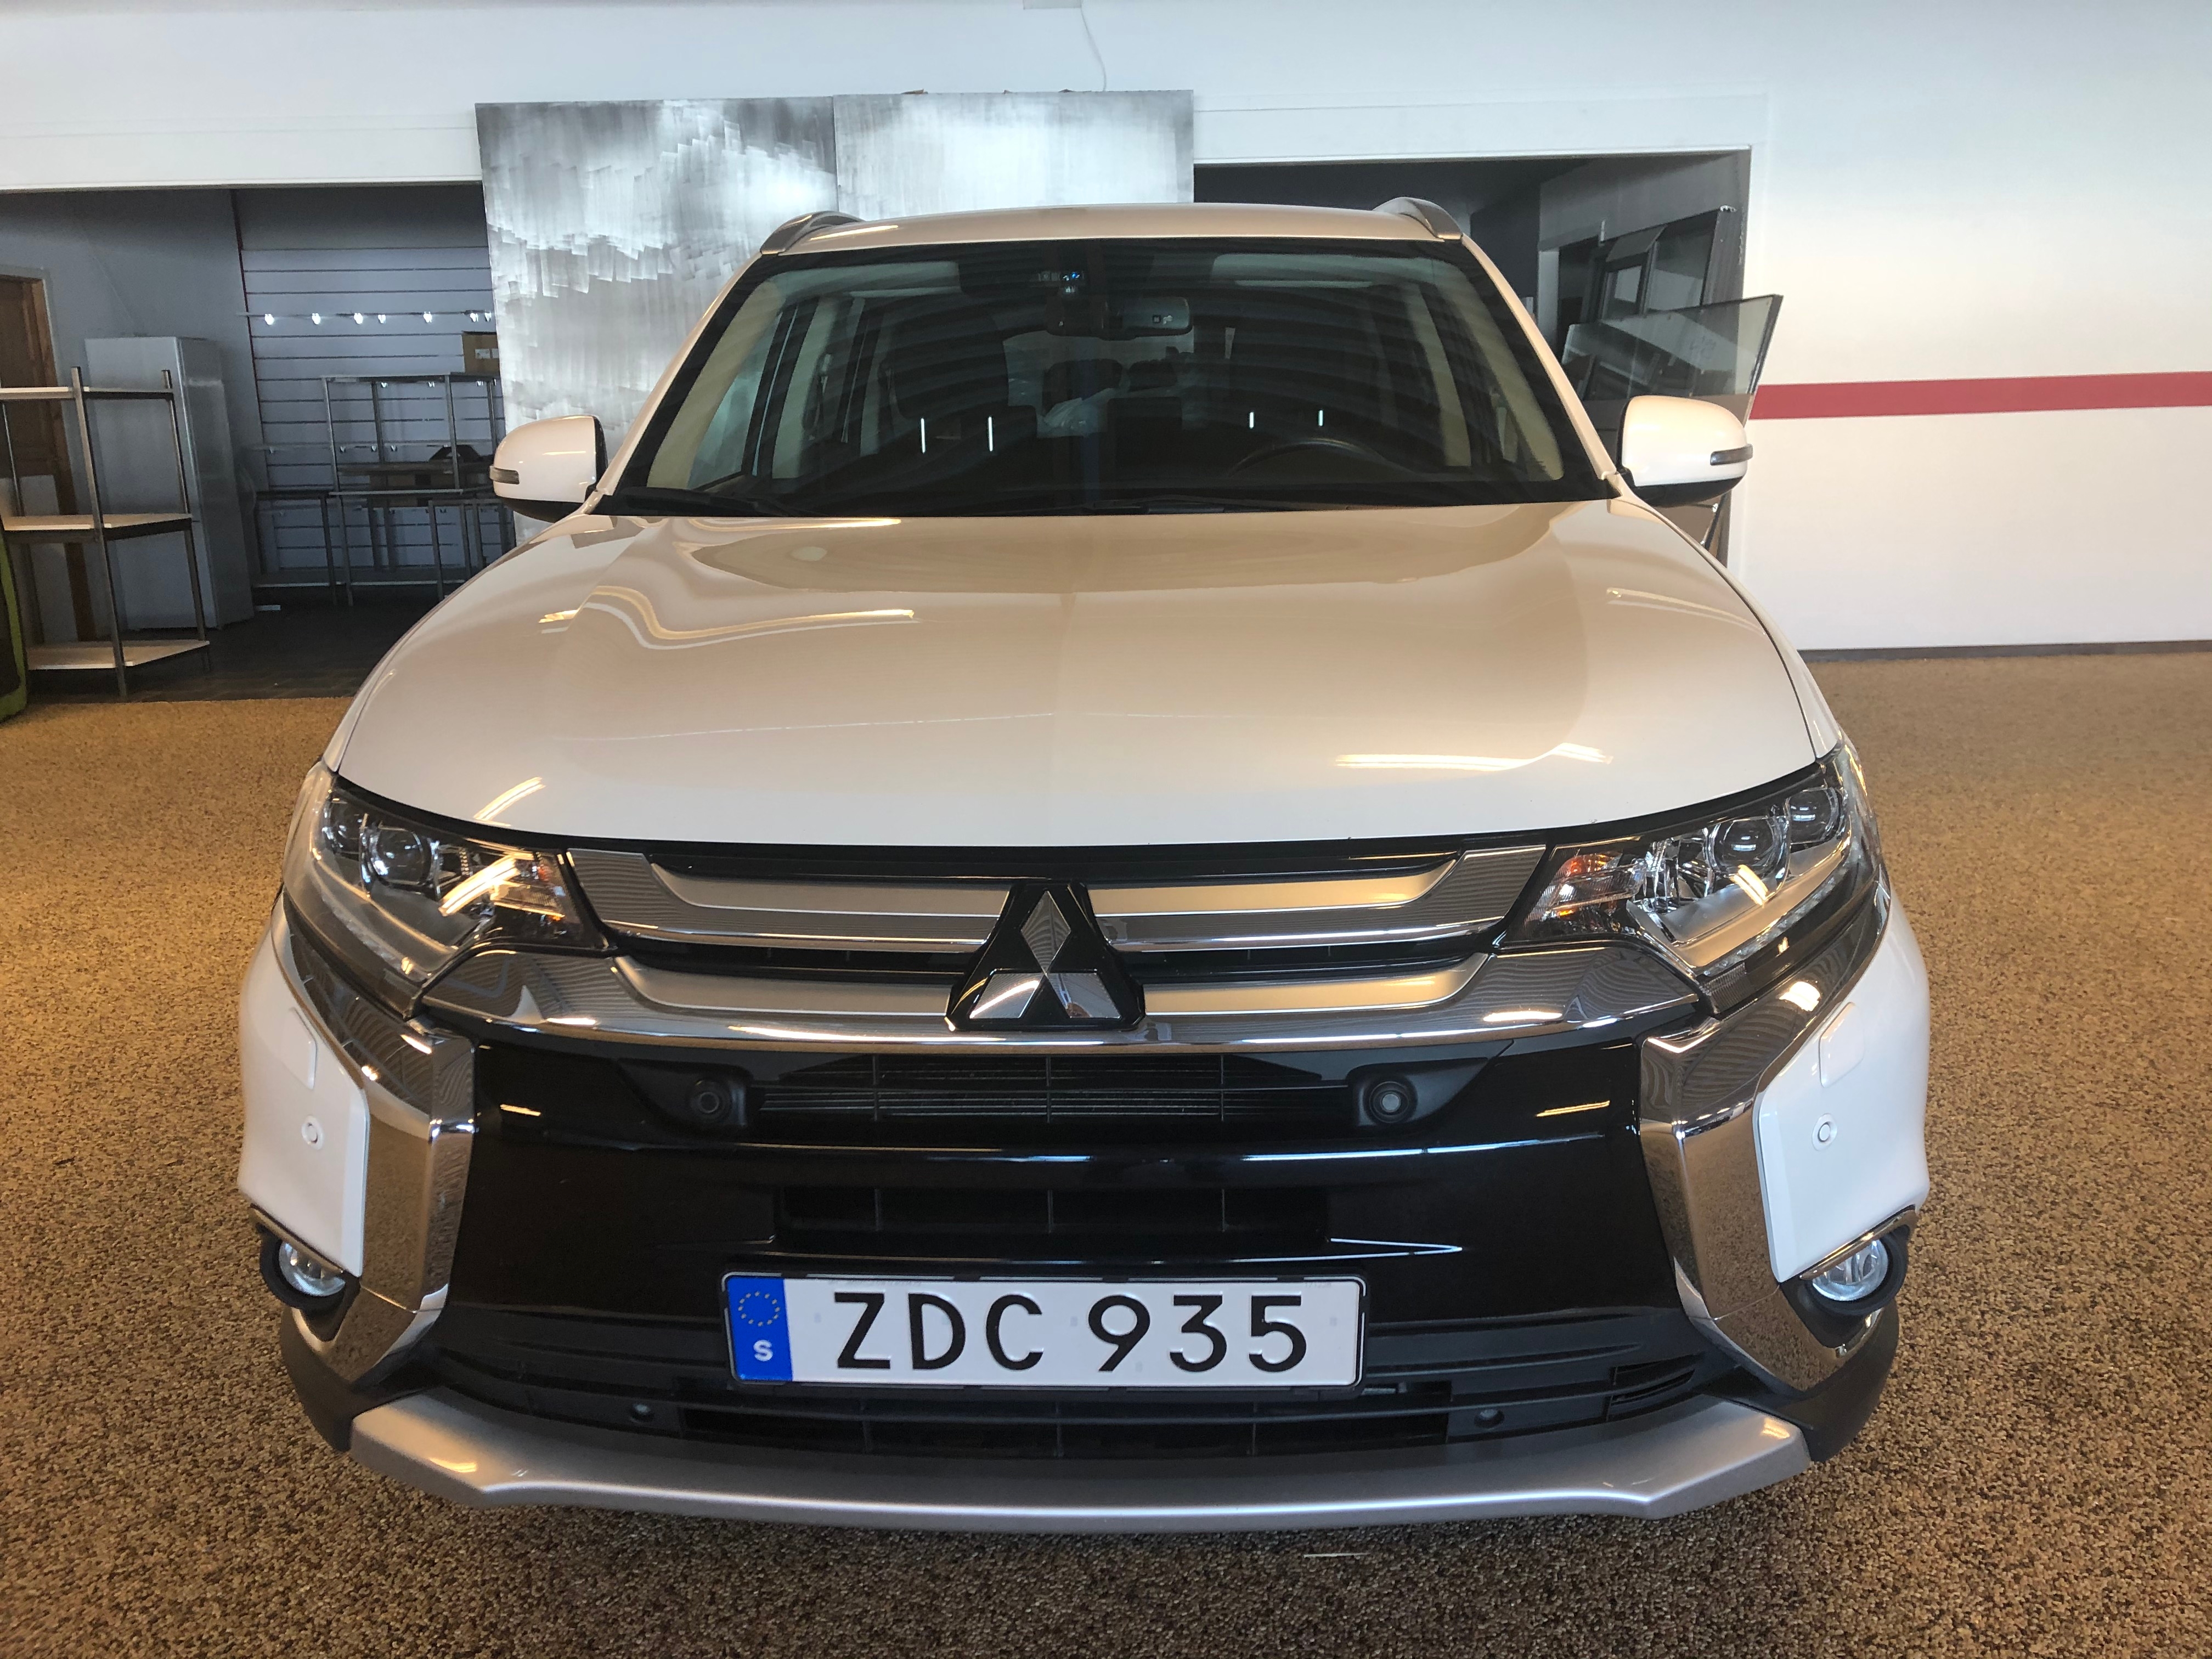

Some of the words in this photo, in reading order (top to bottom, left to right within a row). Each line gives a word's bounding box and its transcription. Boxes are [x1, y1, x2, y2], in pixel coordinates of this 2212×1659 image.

[753, 1340, 773, 1362] S
[834, 1291, 1043, 1370] ZDC
[1088, 1294, 1307, 1373] 935
